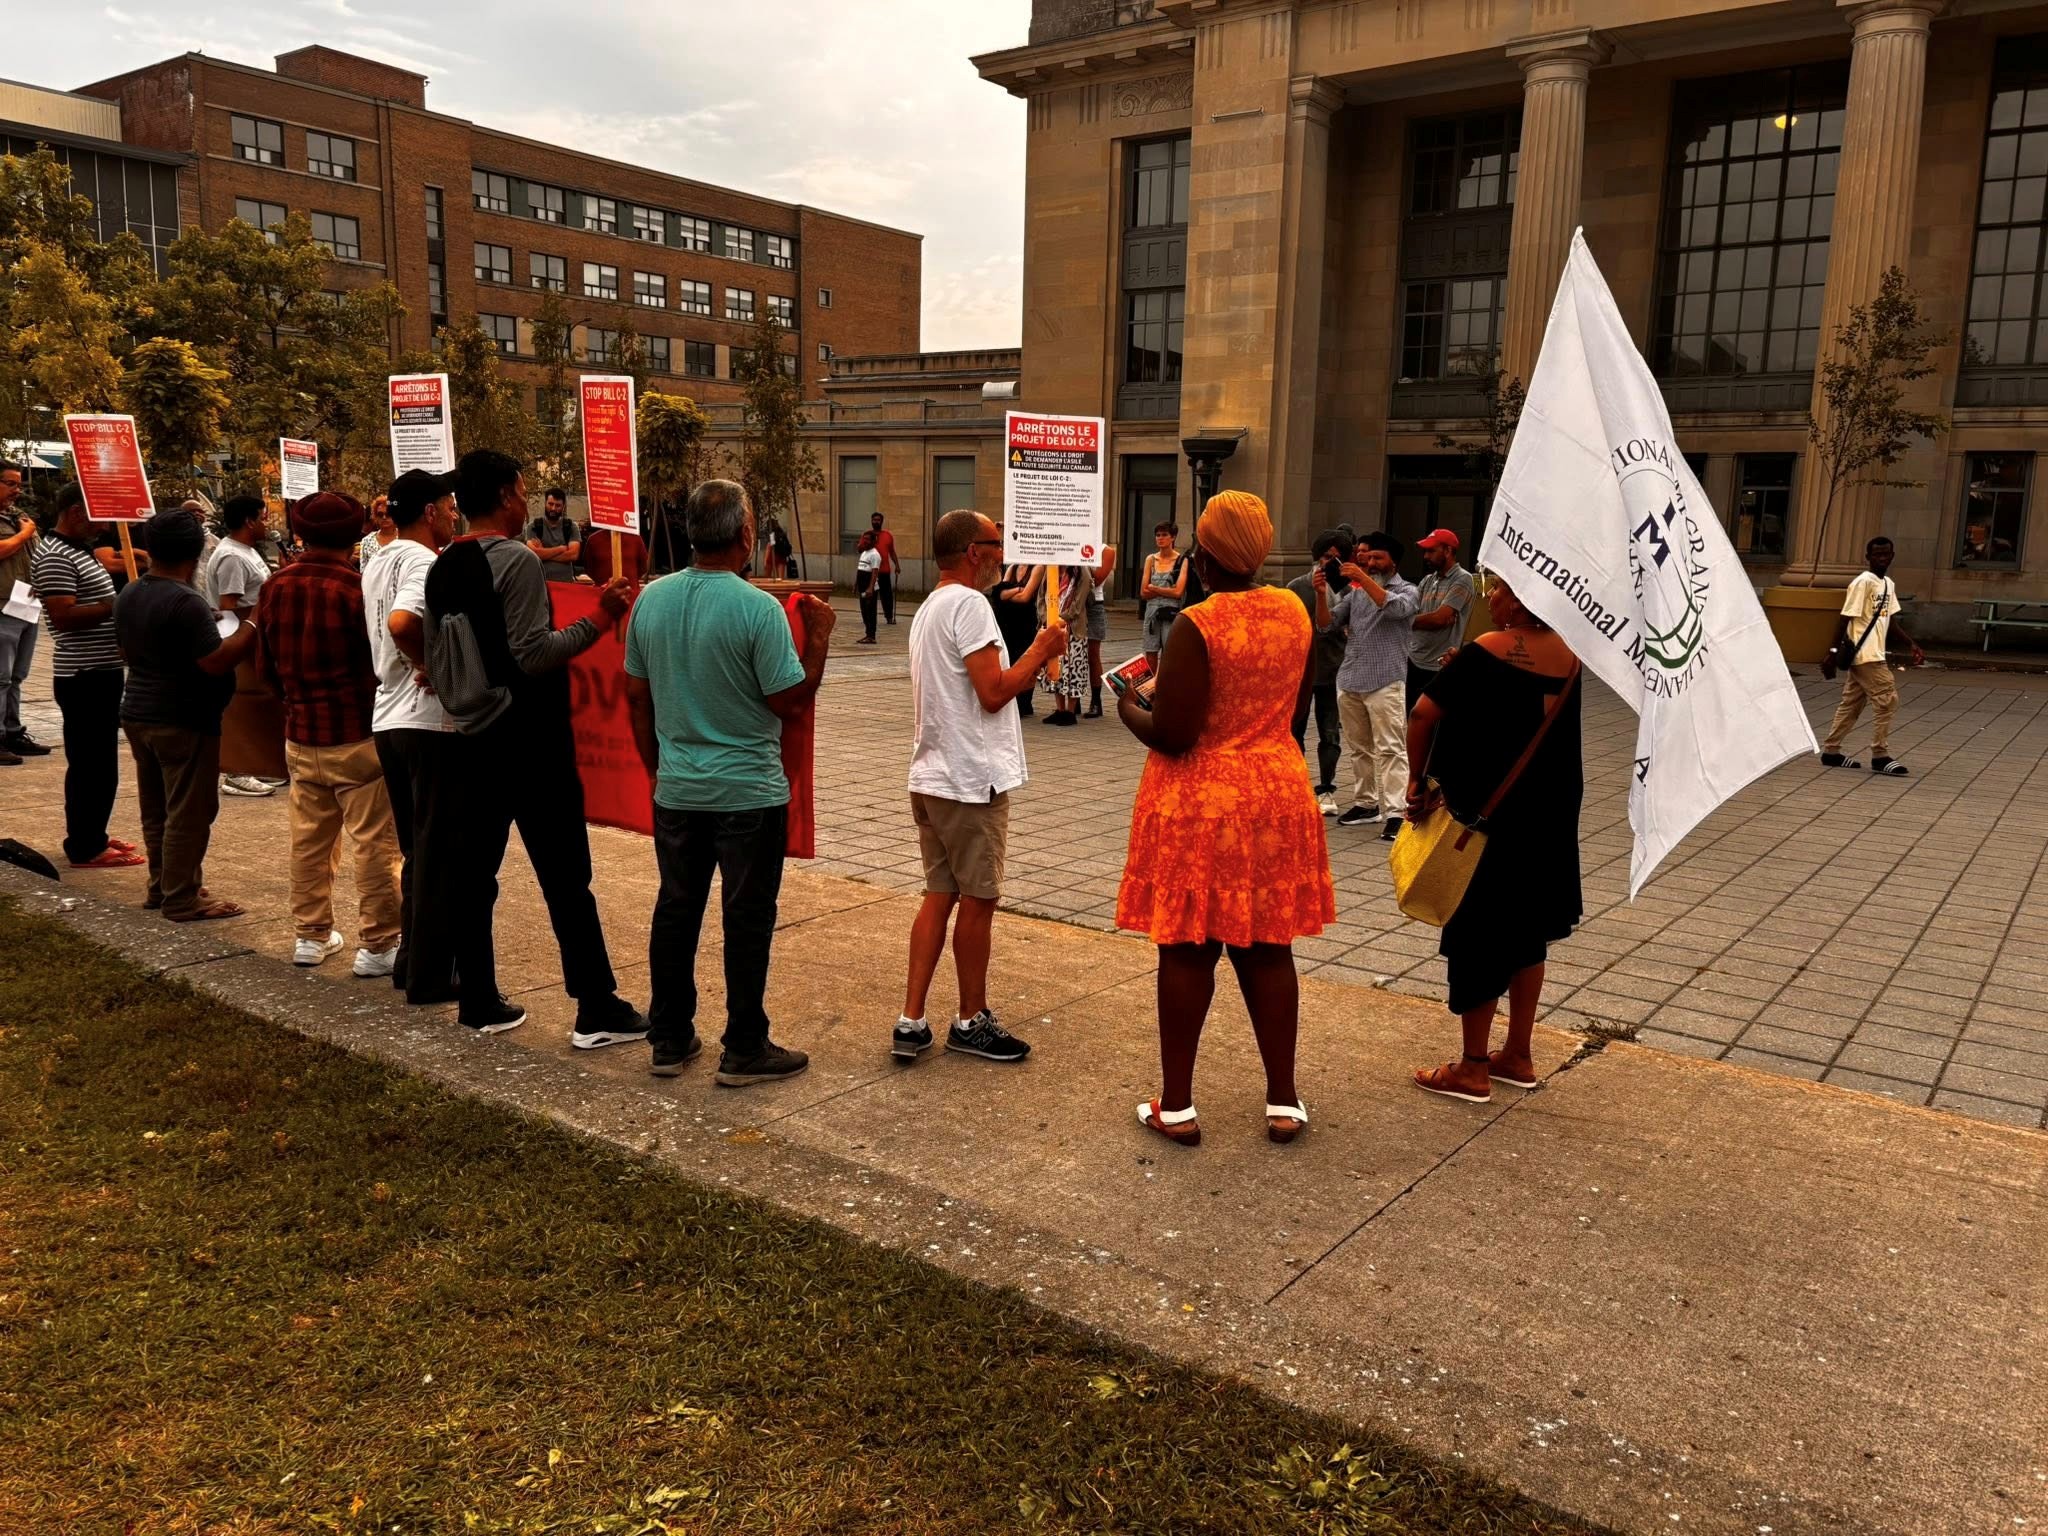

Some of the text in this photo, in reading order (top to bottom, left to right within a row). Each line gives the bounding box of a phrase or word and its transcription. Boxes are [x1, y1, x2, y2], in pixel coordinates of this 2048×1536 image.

[394, 382, 438, 393] ARRÊTONS LE
[585, 386, 626, 400] STOP BILL C-2
[392, 392, 440, 402] PROJET DE LOI C-2
[72, 423, 130, 433] STOP BILL C-2
[1016, 422, 1090, 436] ARRÊTONS LE
[1010, 433, 1096, 447] PROJET DE LOI C-2
[1023, 449, 1060, 458] PROTÉGEONS
[1497, 511, 1630, 642] International
